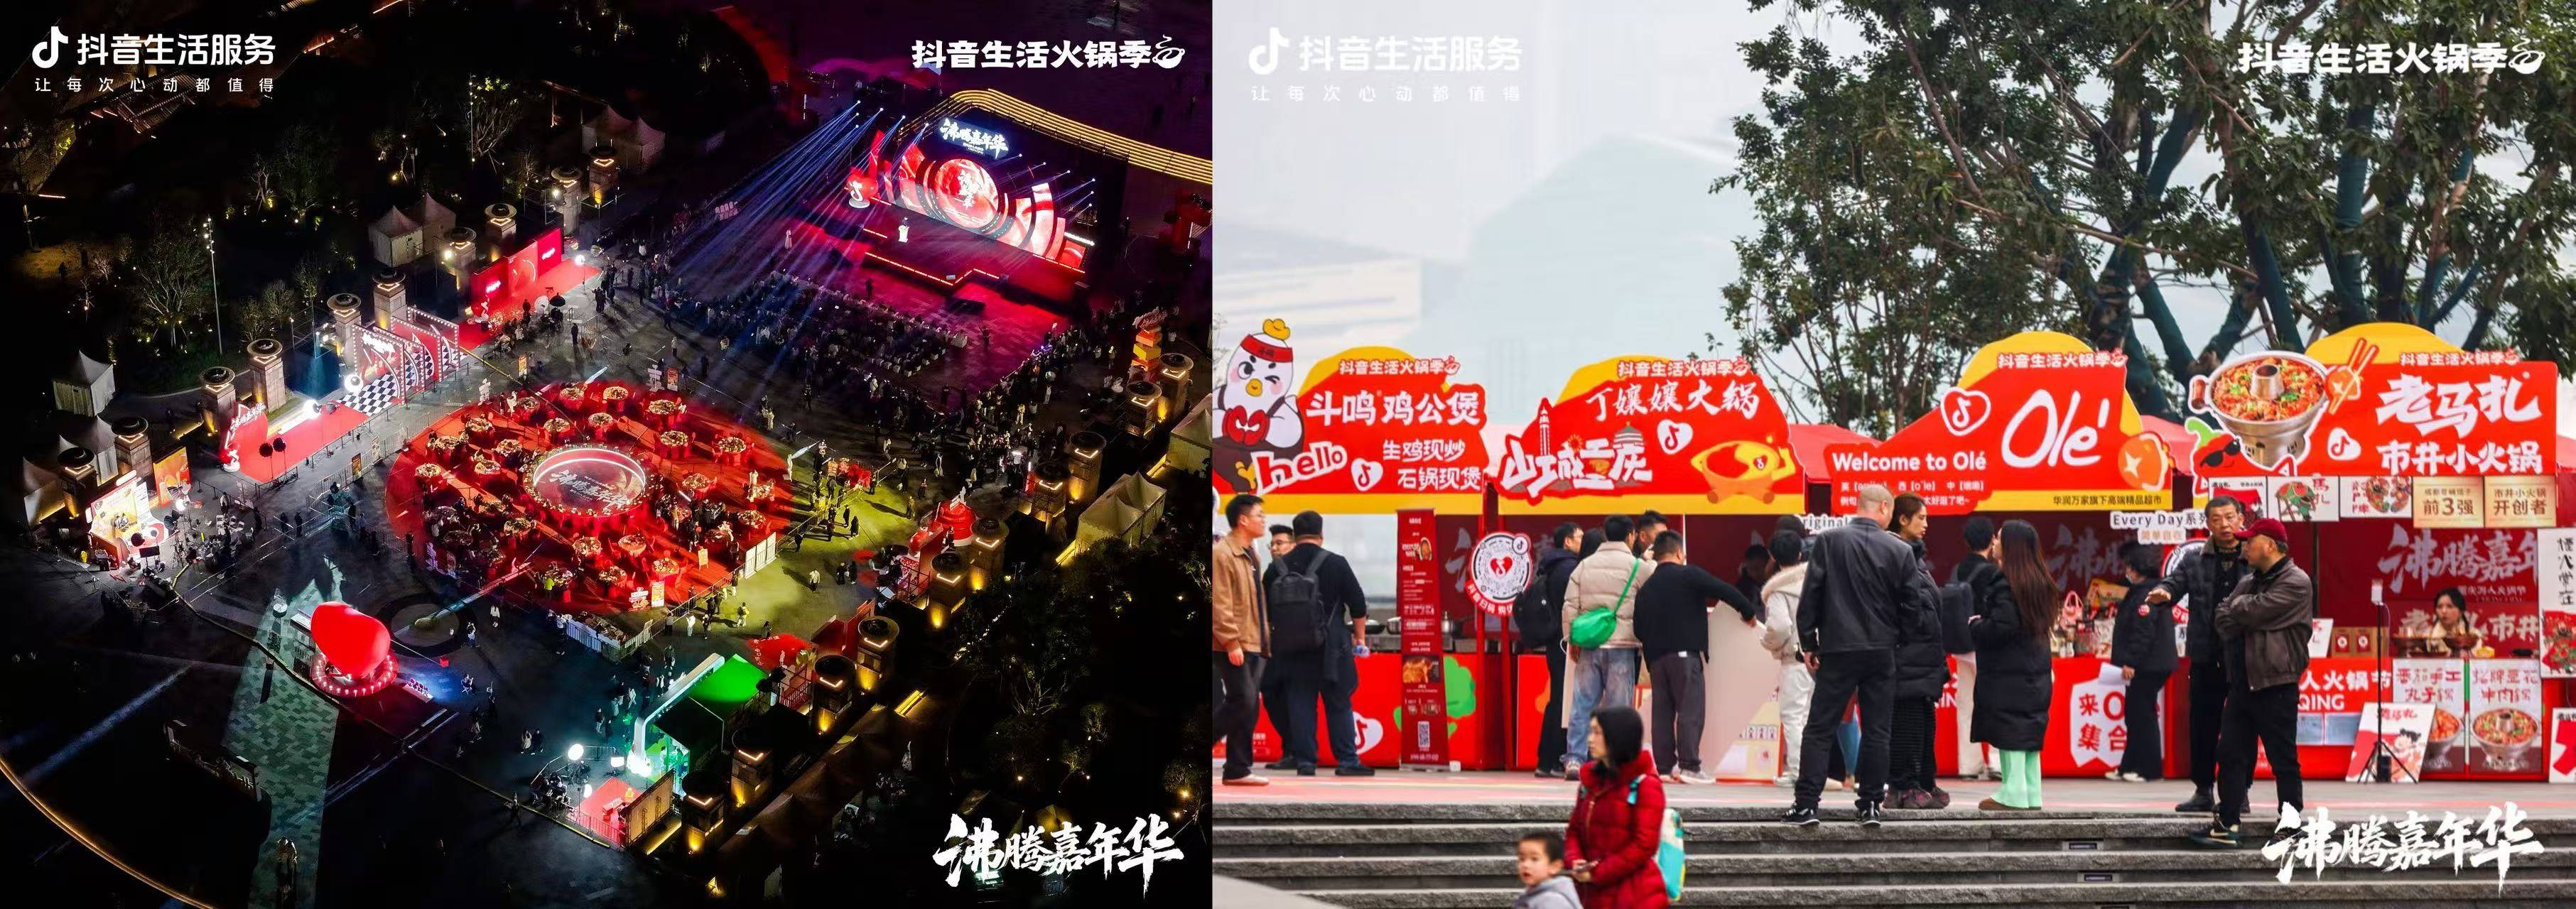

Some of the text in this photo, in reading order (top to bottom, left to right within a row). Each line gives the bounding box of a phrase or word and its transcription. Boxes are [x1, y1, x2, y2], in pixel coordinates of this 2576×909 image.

[1339, 359, 1444, 375] 抖音生活火锅季
[1997, 352, 2111, 369] 抖音生活火锅季
[2399, 352, 2506, 367] 抖音生活火锅季
[1617, 360, 1733, 379] 抖音生活火锅季
[2376, 372, 2542, 440] 老马扎
[1382, 439, 1466, 462] 生鸡现炒
[2376, 440, 2543, 476] 市井小火锅
[1253, 440, 1348, 496] hello
[1832, 451, 1987, 472] Welcome to Olé
[1397, 467, 1483, 491] 石锅现煲
[2053, 495, 2162, 506] 华润万家旗下高端精品超市
[2423, 497, 2474, 516] 前3强
[2494, 499, 2548, 516] 开创者
[1803, 517, 1849, 530] riginal
[2113, 513, 2154, 527] Every
